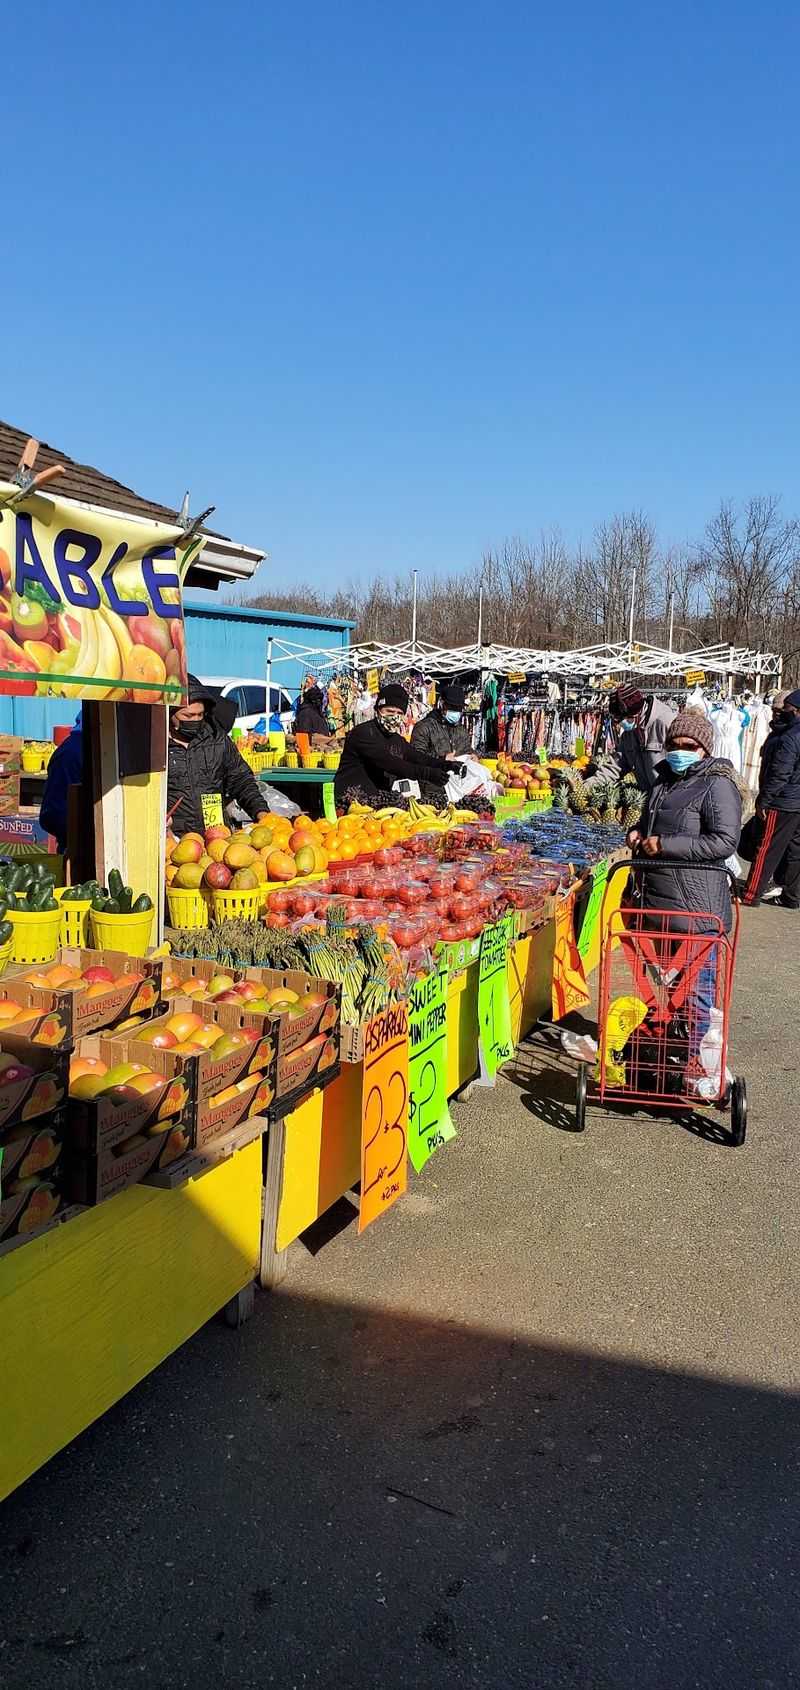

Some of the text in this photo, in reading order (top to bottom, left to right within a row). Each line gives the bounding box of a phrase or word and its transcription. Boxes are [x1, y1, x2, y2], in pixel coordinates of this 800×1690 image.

[0, 512, 182, 618] ABLE
[78, 994, 123, 1017] Mangoes
[408, 970, 447, 1016] SWEET
[283, 1016, 315, 1037] Mangoes
[202, 1055, 243, 1080] Mangoes
[201, 1103, 243, 1129] Mangoes
